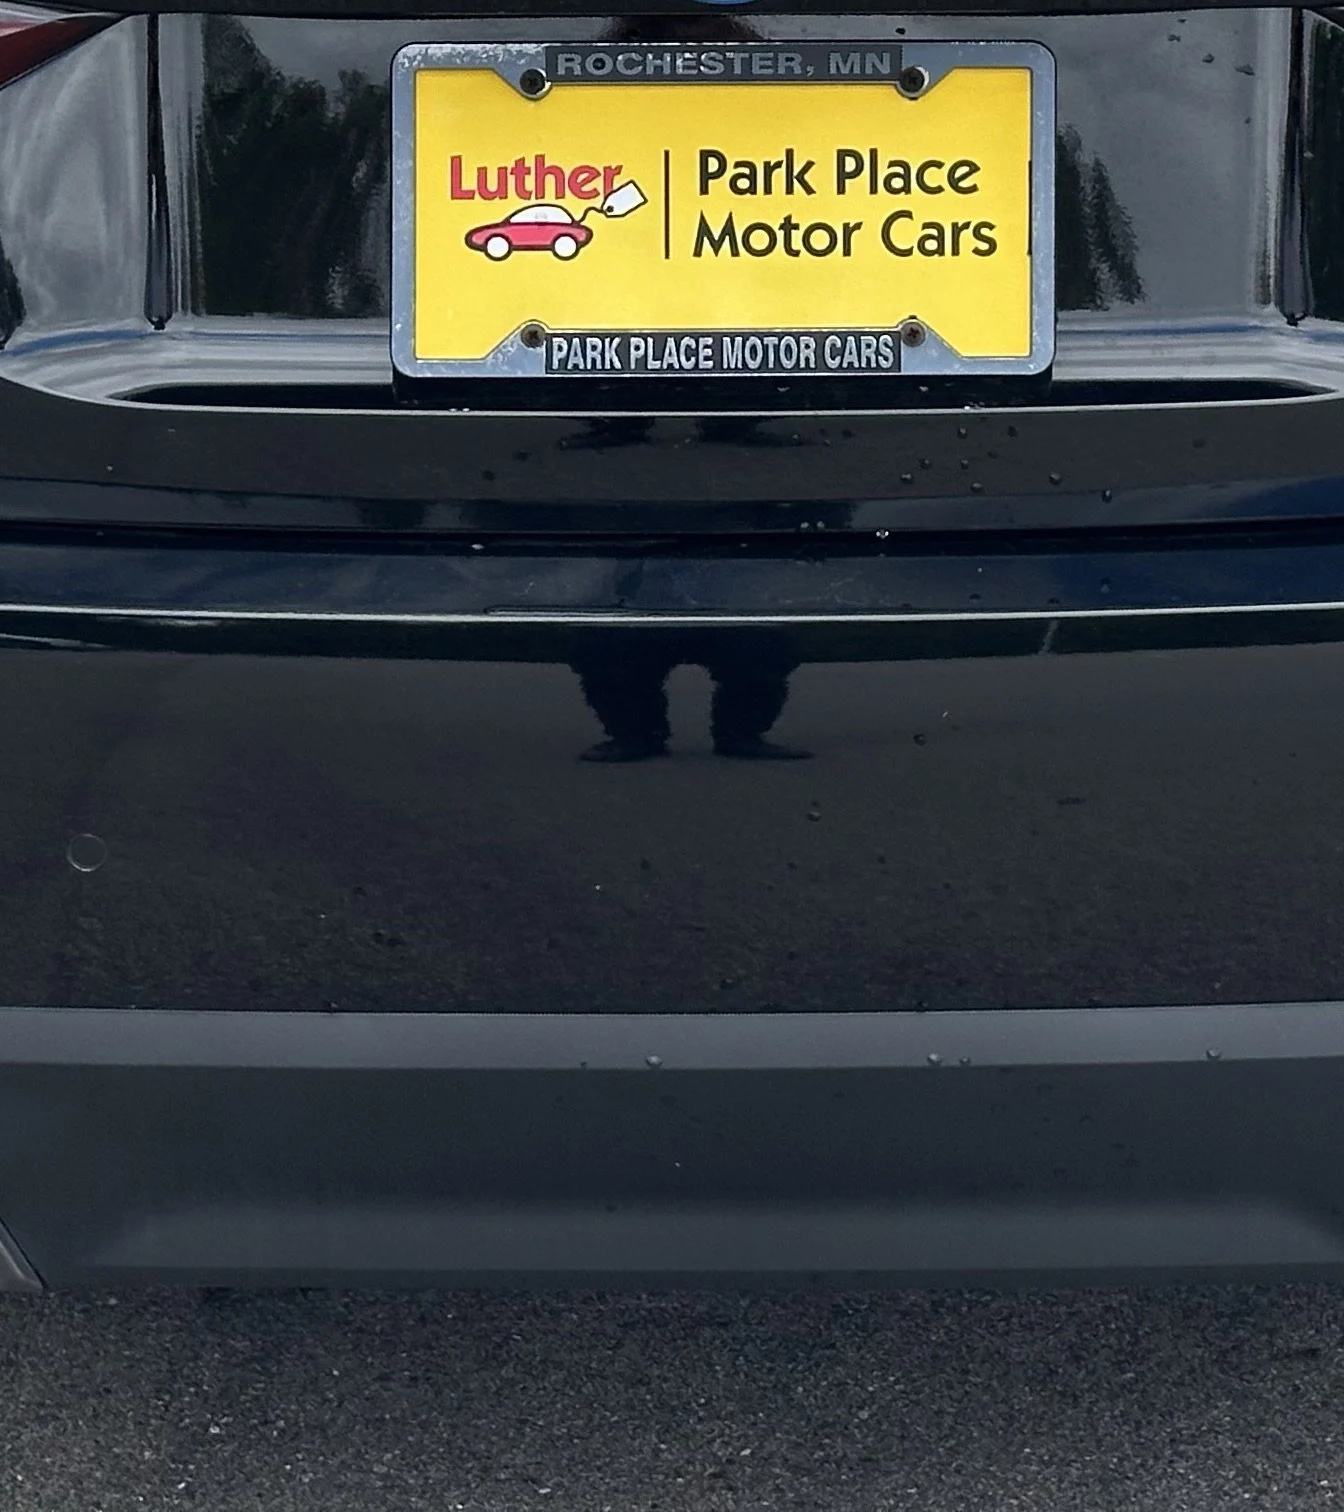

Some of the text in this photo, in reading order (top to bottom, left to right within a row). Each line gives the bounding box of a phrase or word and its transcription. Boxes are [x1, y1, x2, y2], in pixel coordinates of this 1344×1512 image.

[556, 51, 892, 77] ROCHESTER, MN
[450, 154, 623, 200] Luther
[698, 148, 982, 196] Park Place
[692, 210, 998, 257] Motor Cars
[551, 334, 895, 370] PARK PLACE MOTOR CARS
